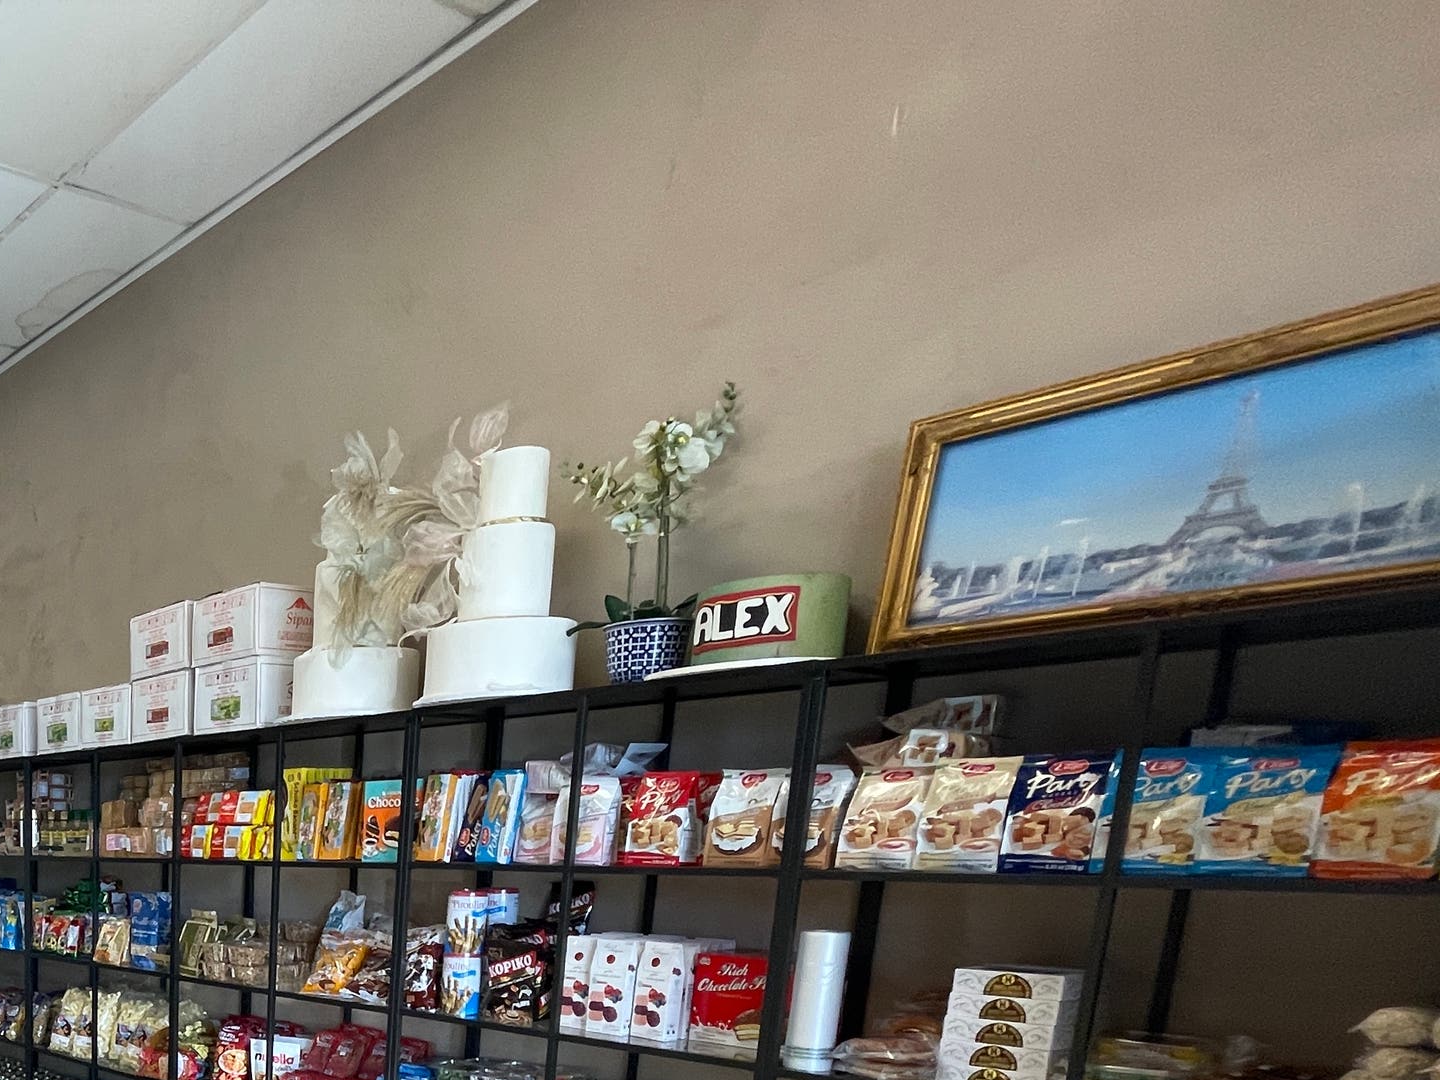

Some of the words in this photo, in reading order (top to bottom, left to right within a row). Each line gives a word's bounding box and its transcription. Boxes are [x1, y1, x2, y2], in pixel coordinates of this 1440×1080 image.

[693, 592, 795, 647] ALEX
[465, 819, 482, 857] Poker
[489, 954, 533, 977] KOPIKO
[717, 963, 749, 977] Rich
[697, 977, 747, 992] Chocolate
[254, 1053, 294, 1065] nella
